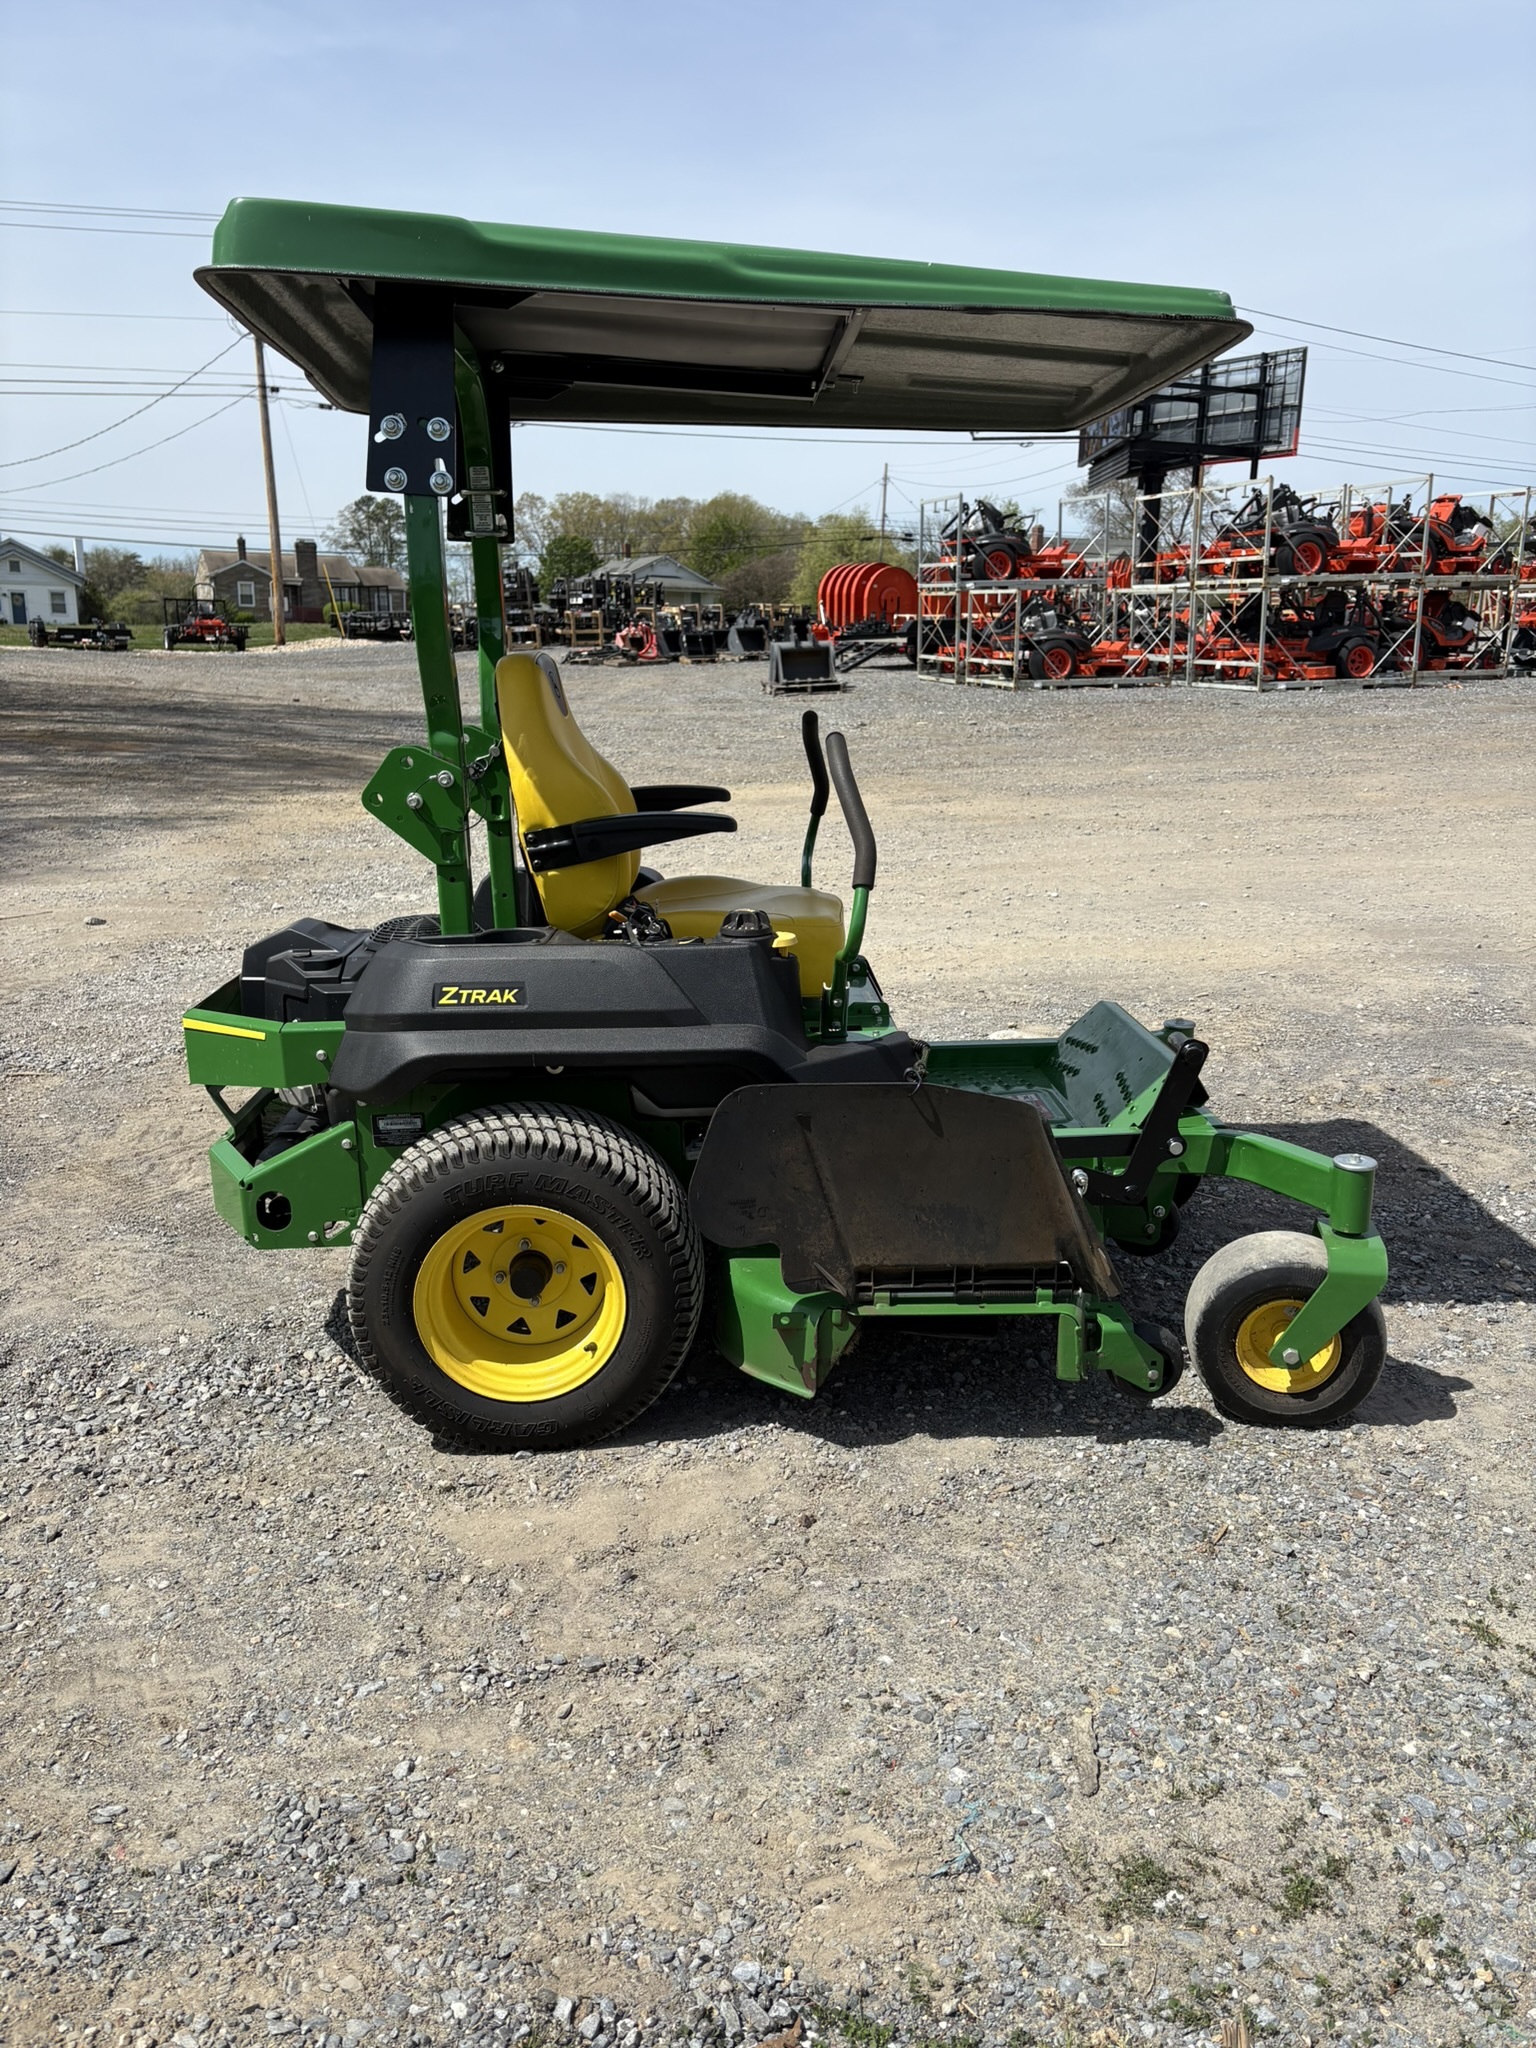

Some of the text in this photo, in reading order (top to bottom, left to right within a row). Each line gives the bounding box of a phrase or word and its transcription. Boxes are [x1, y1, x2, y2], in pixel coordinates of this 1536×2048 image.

[438, 986, 519, 1005] ZTRAK
[442, 1171, 653, 1259] TURF MASTER
[403, 1374, 559, 1437] CARLISLE
